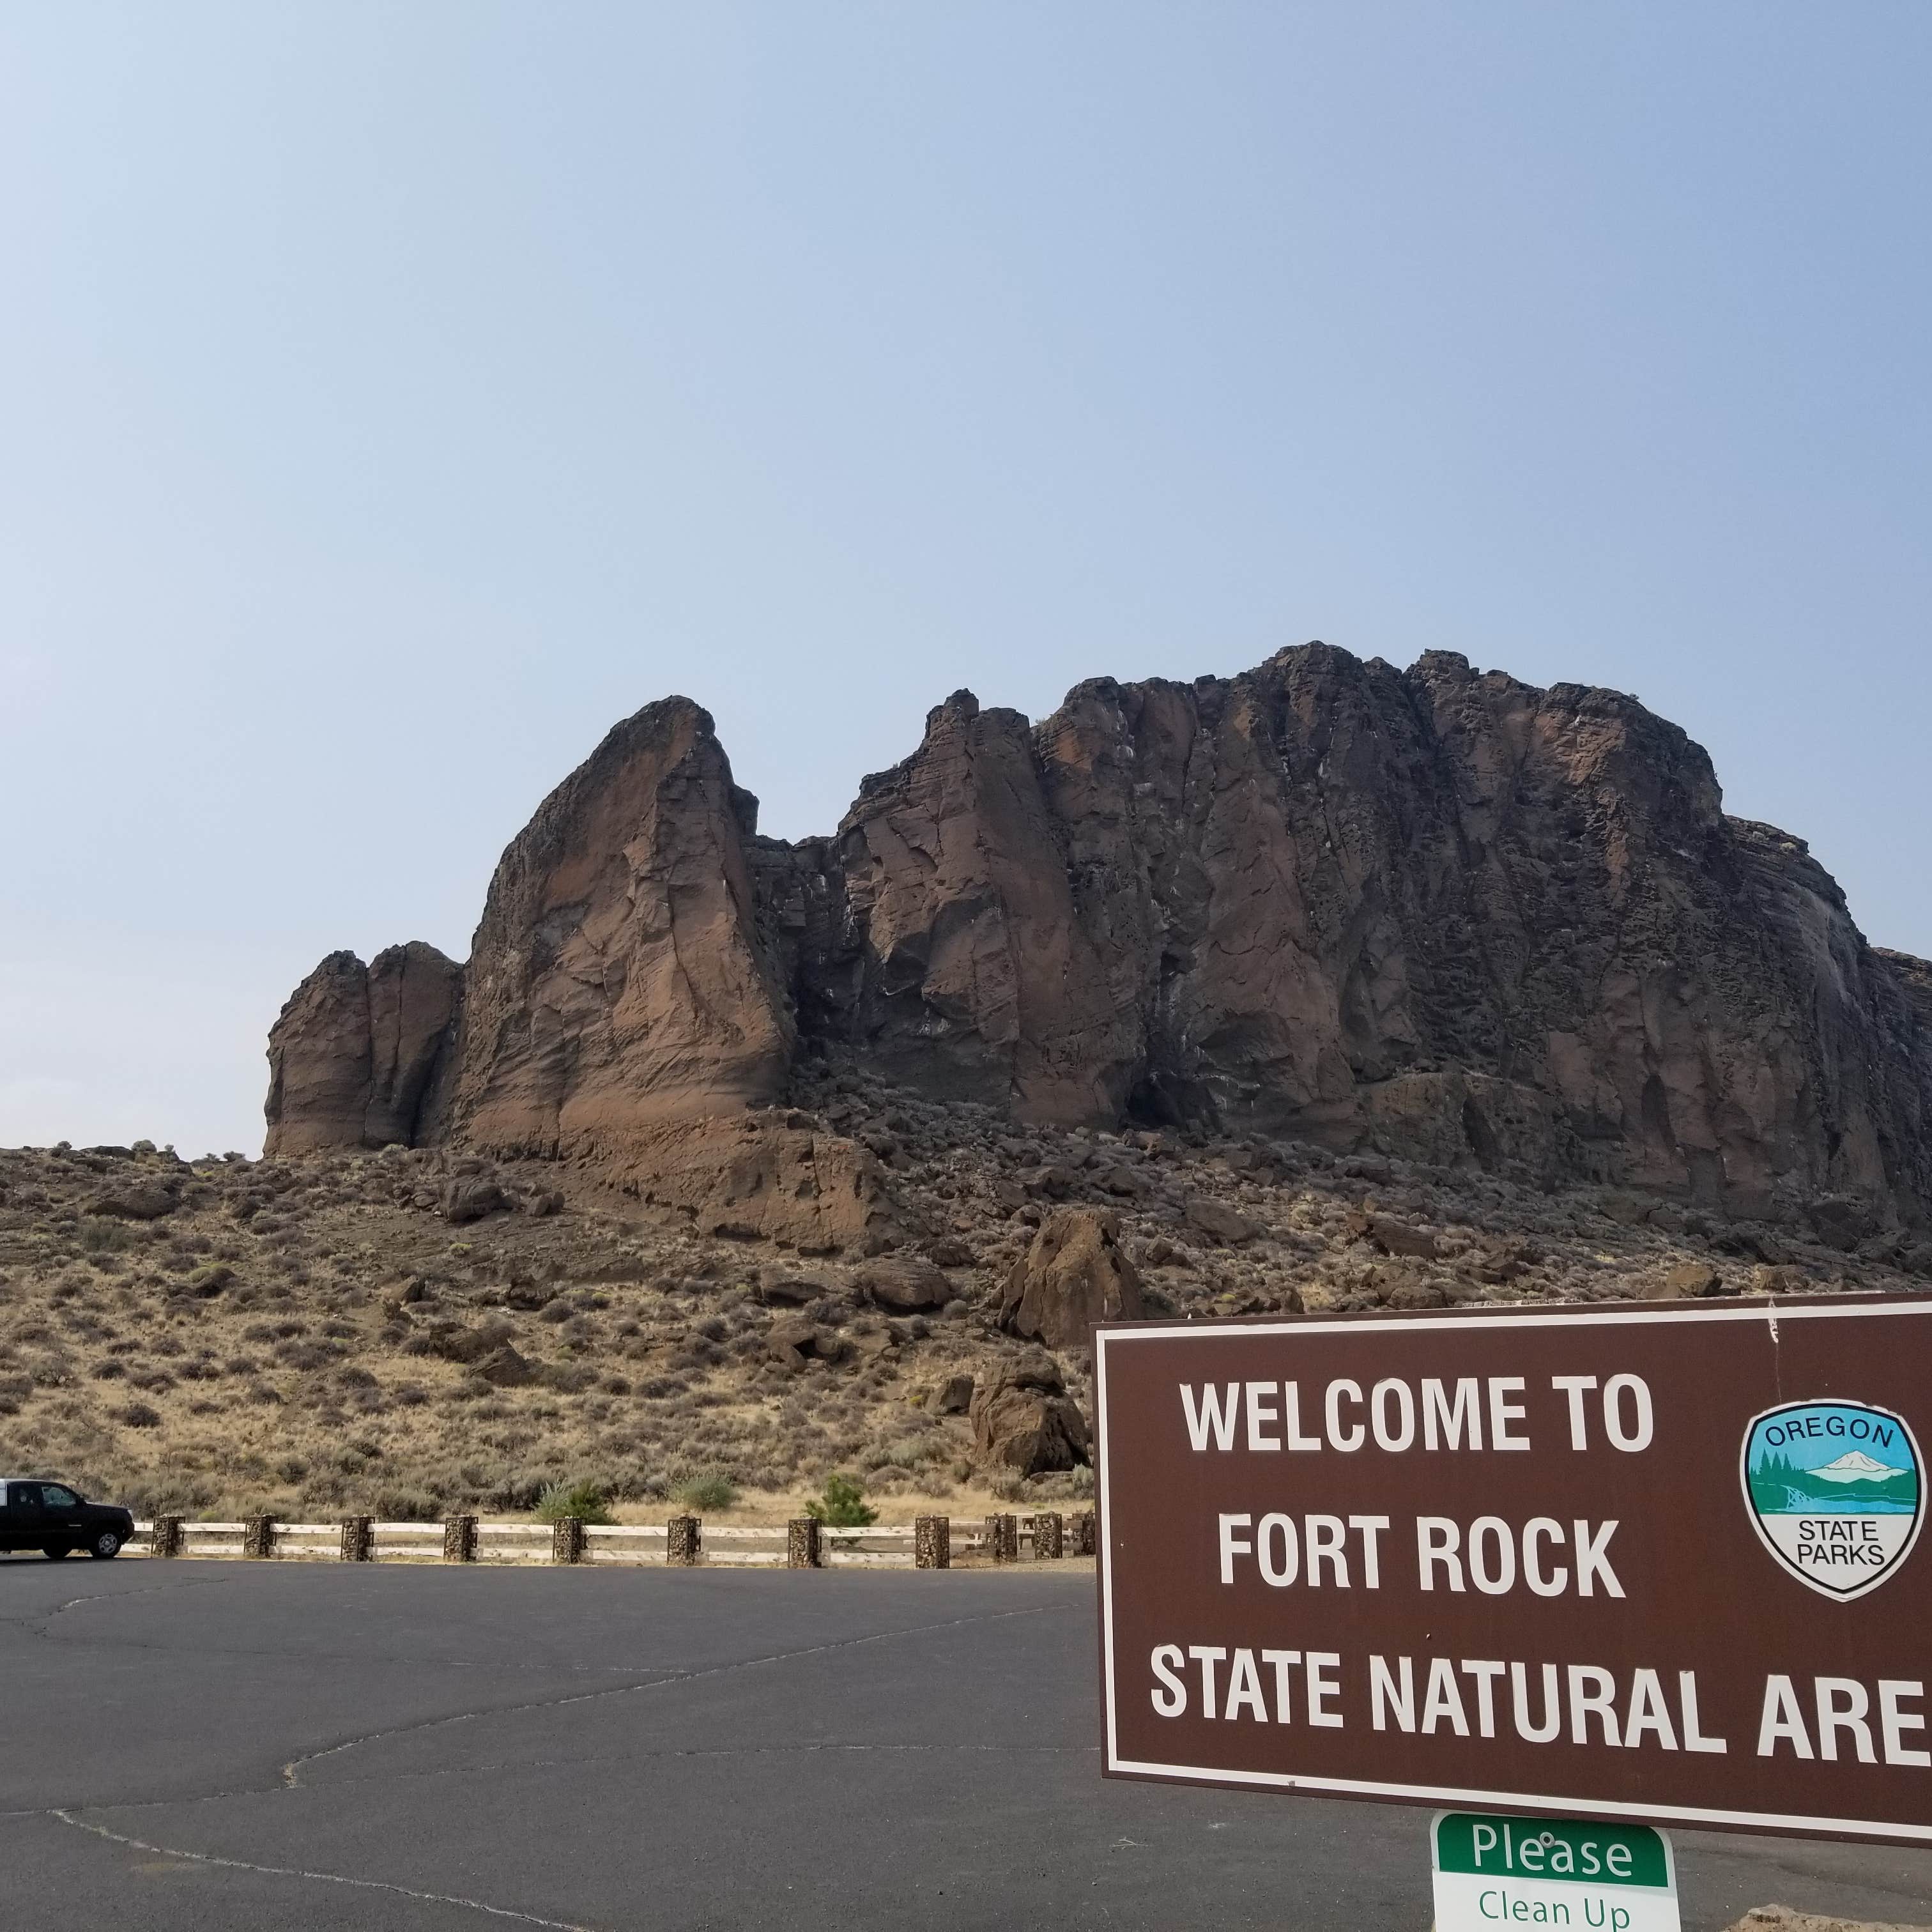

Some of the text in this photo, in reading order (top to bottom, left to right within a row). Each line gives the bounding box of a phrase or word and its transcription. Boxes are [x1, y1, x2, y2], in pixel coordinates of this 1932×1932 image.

[1180, 1374, 1653, 1452] WELCOME TO
[1765, 1416, 1894, 1448] OREGON
[1797, 1544, 1885, 1566] PARKS
[1798, 1520, 1879, 1542] STATE
[1219, 1513, 1626, 1598] FORT ROCK
[1151, 1644, 1931, 1767] STATE NATURAL ARE
[1472, 1823, 1632, 1877] Please
[1479, 1890, 1630, 1932] Clean Up
